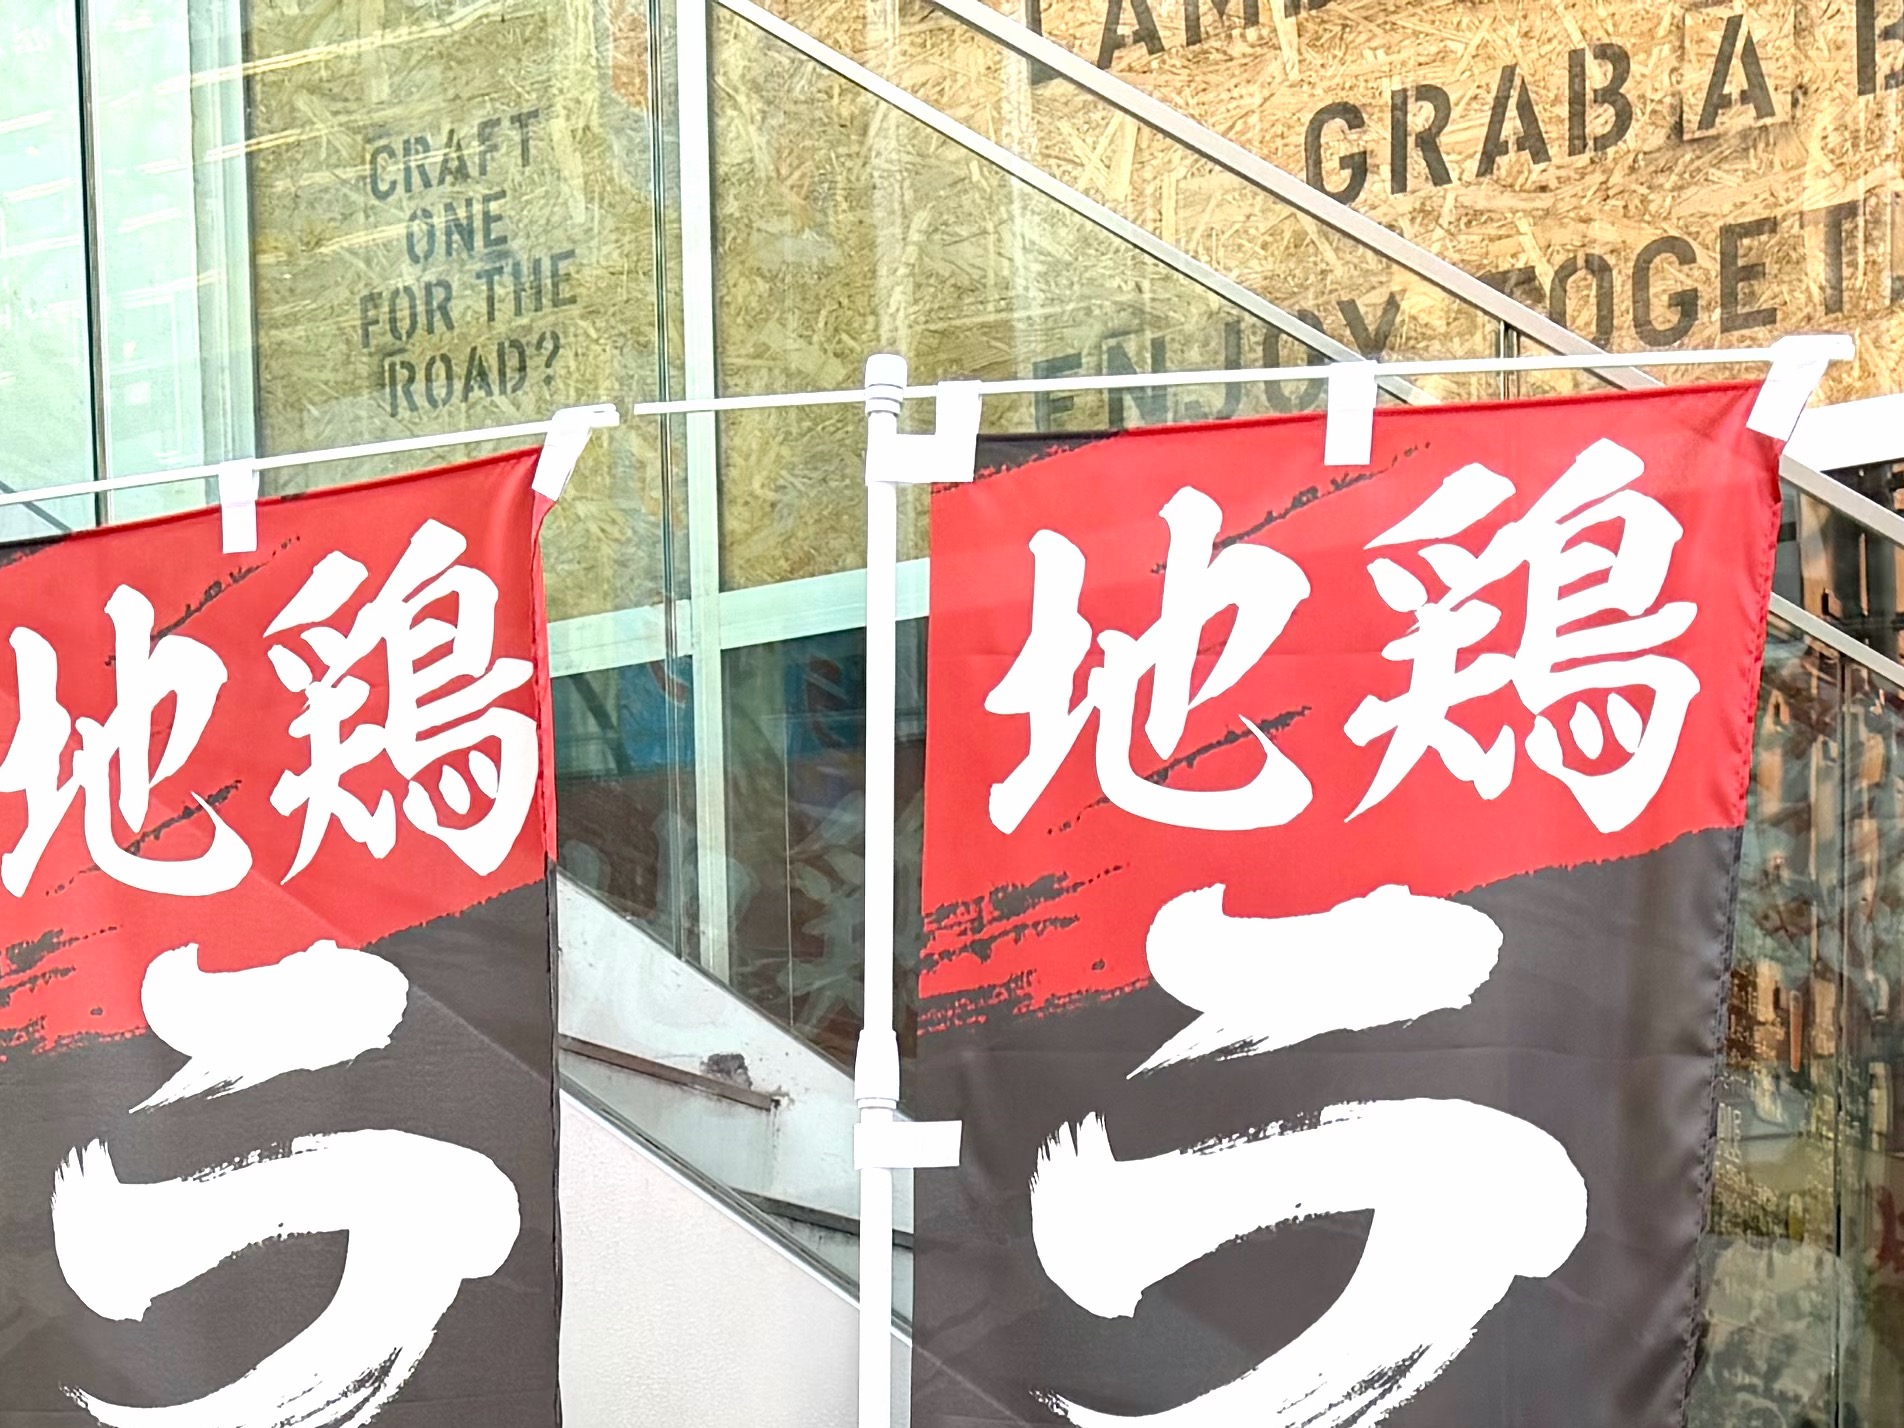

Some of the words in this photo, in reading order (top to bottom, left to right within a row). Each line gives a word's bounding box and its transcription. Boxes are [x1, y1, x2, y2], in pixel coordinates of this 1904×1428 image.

[368, 108, 540, 201] CRAFT
[1303, 43, 1634, 203] GRAB
[1696, 13, 1777, 131] A
[404, 189, 509, 265] ONE
[358, 278, 456, 350] FOR
[475, 249, 578, 323] THE
[382, 329, 562, 419] ROAD?
[984, 437, 1701, 834] 地鶏
